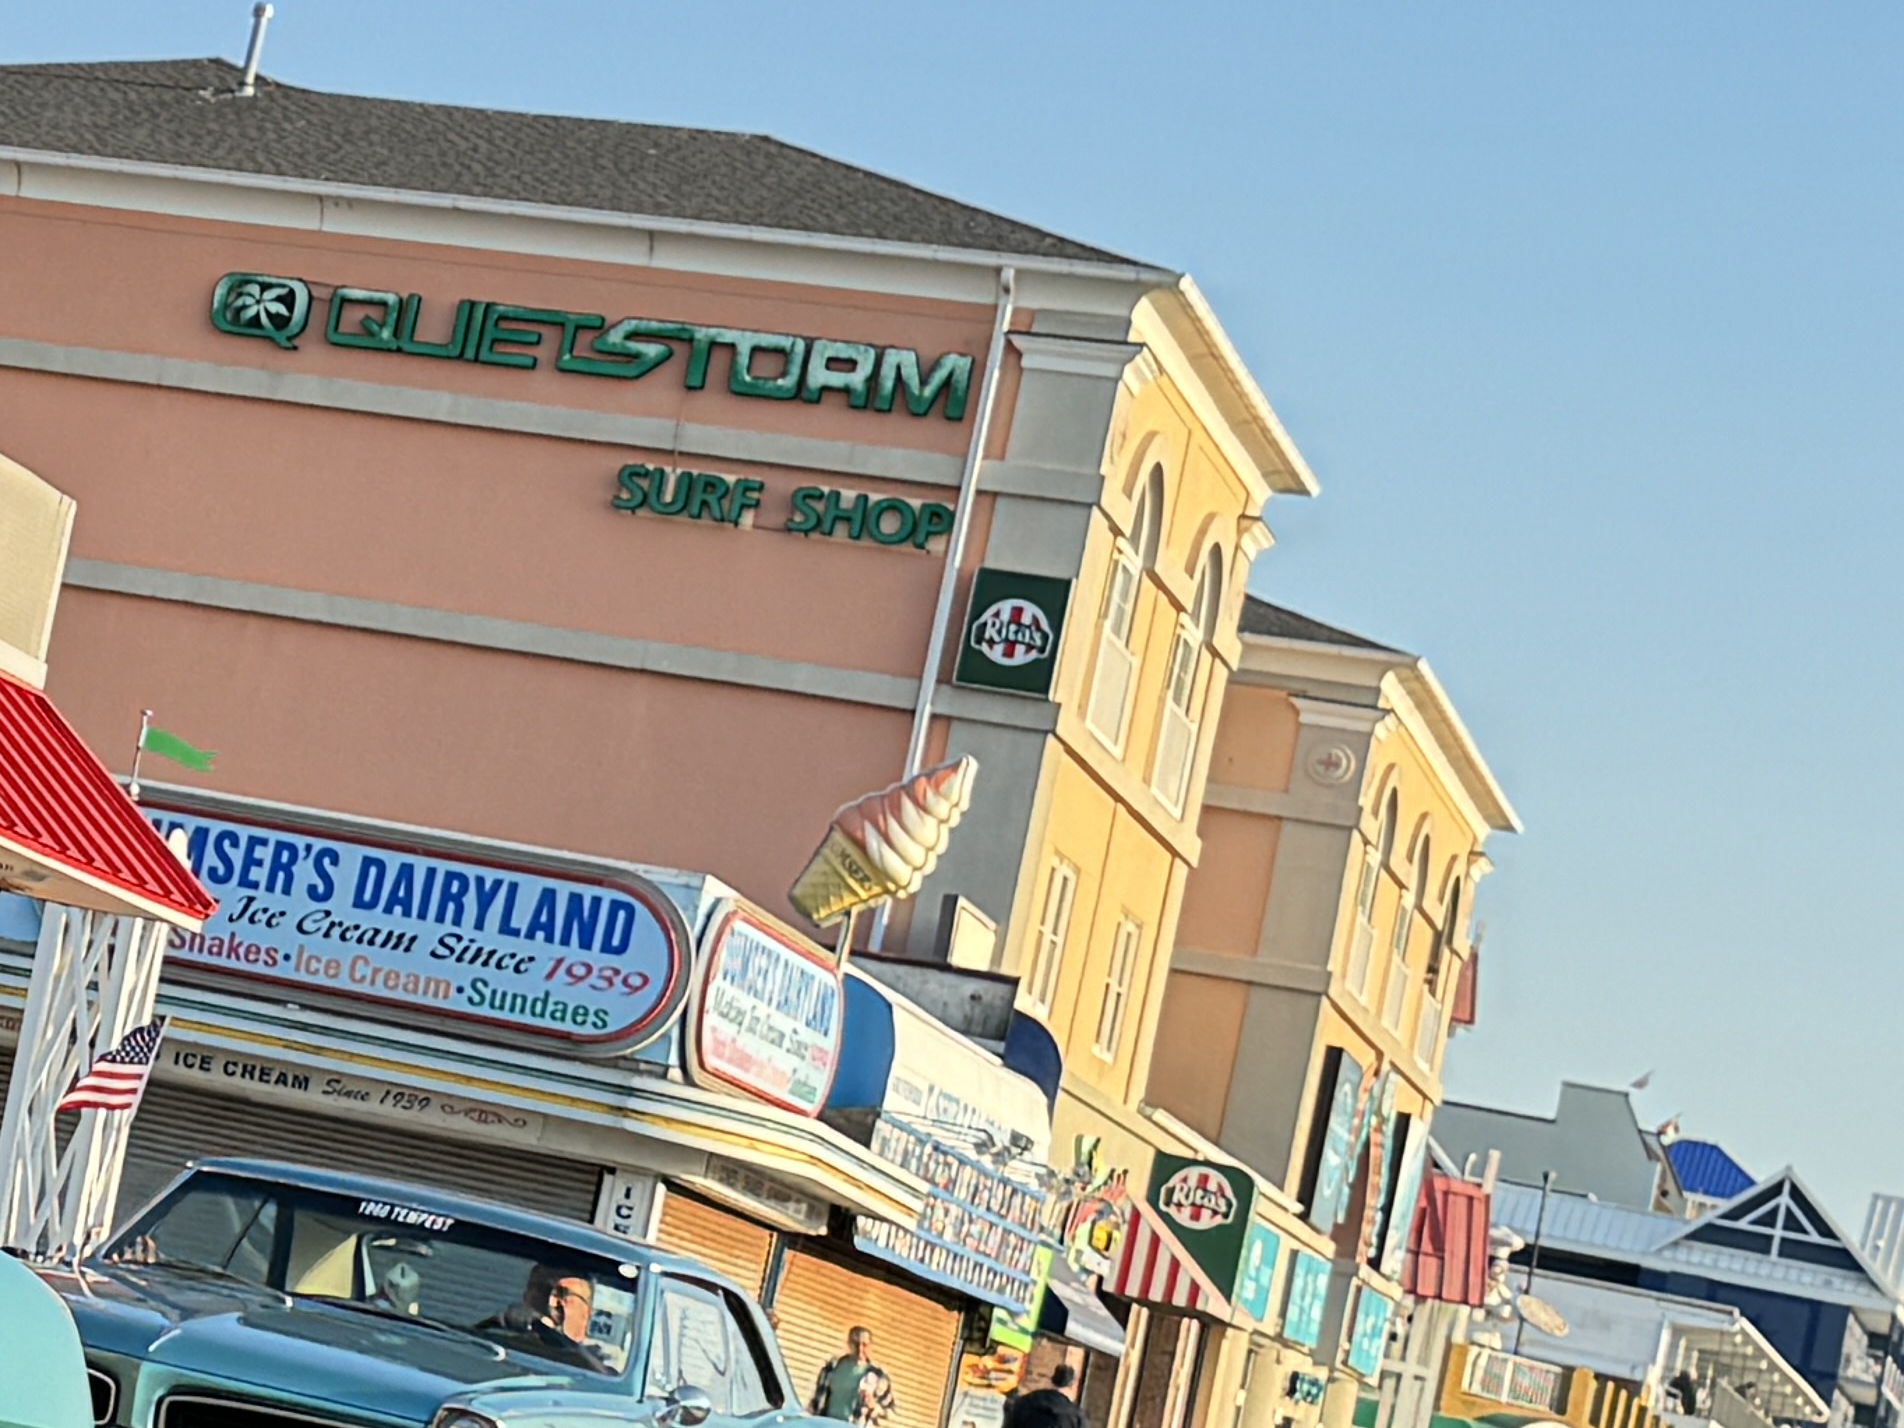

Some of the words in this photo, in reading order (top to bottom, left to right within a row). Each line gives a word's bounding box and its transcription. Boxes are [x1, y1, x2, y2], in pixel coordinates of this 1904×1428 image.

[611, 463, 765, 529] SURF
[786, 486, 955, 554] SHOP
[228, 895, 286, 929] Ice
[296, 909, 419, 954] Cream
[429, 932, 537, 975] Since
[543, 955, 650, 997] 1939
[352, 854, 636, 957] DAIRYLAND
[294, 944, 341, 979] Ice
[348, 954, 453, 1001] Cream
[467, 977, 611, 1031] Sundaes
[173, 1050, 213, 1073] ICE
[222, 1060, 311, 1092] CREAM
[378, 1089, 432, 1113] 1939
